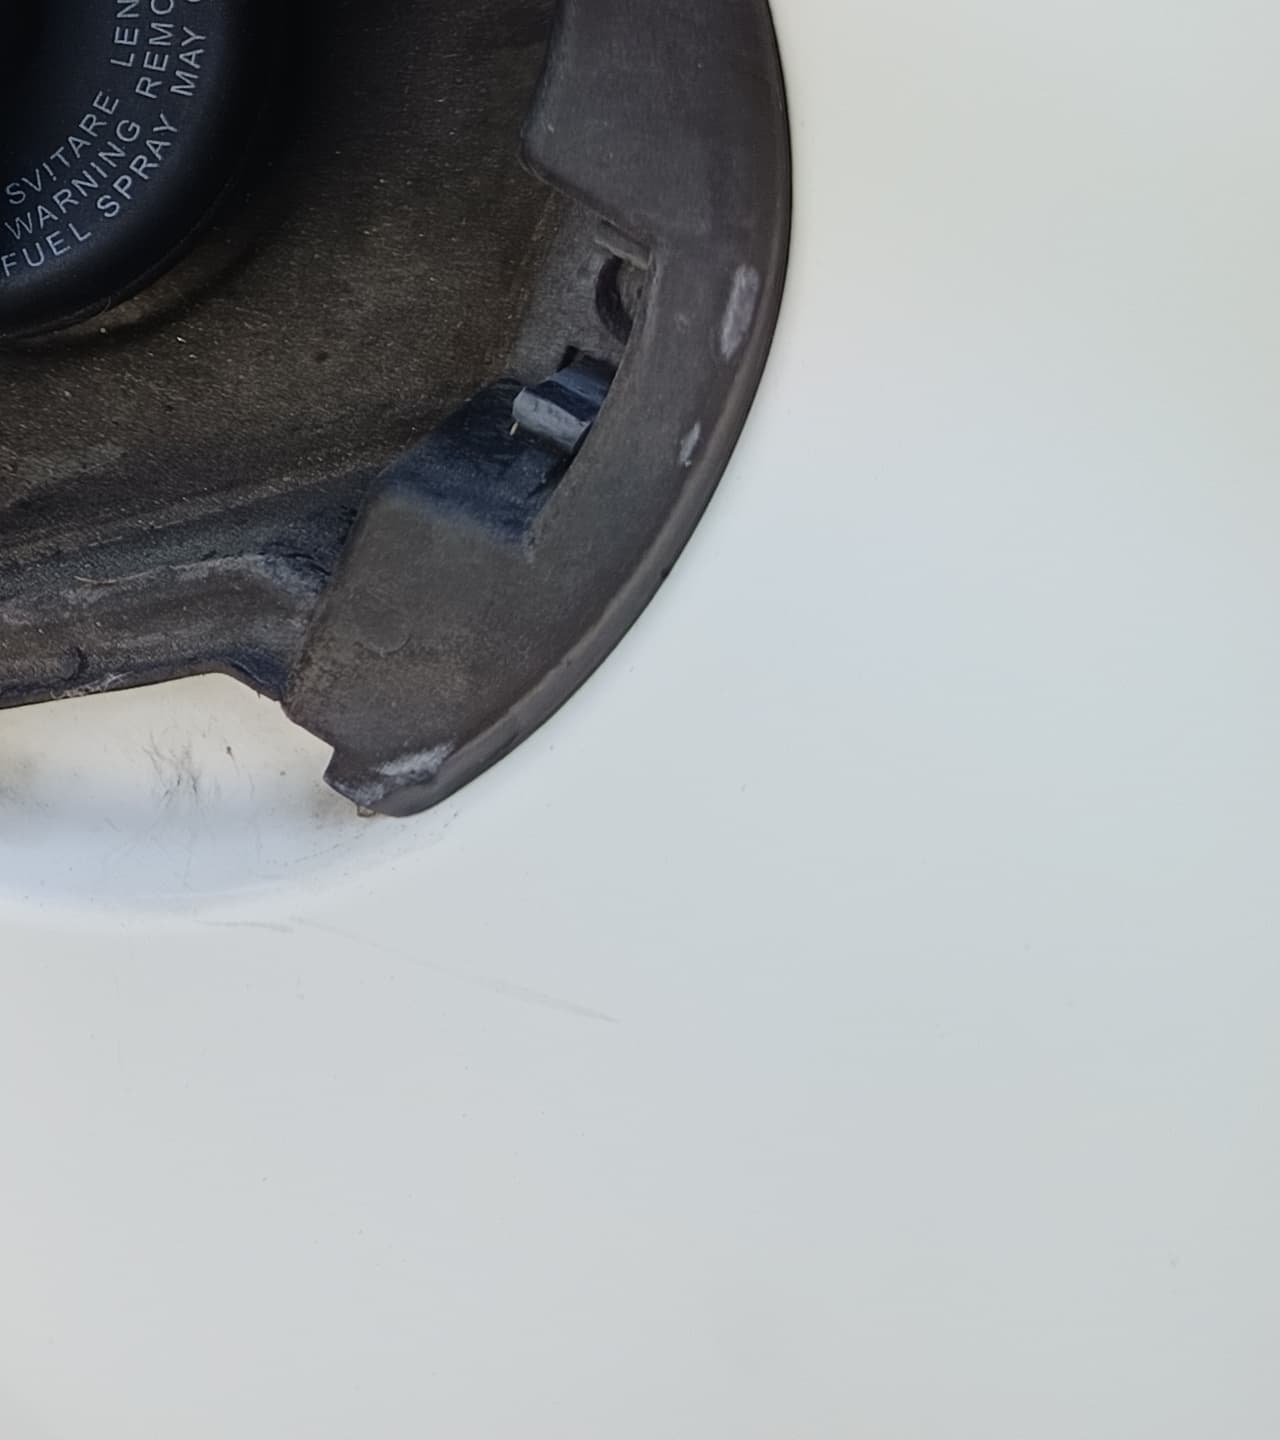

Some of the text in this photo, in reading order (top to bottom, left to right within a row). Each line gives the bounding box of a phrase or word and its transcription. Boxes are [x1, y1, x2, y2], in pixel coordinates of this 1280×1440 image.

[0, 223, 91, 277] FUEL
[97, 113, 179, 218] SPRAY
[171, 29, 207, 95] MAY
[6, 120, 139, 239] WARNING
